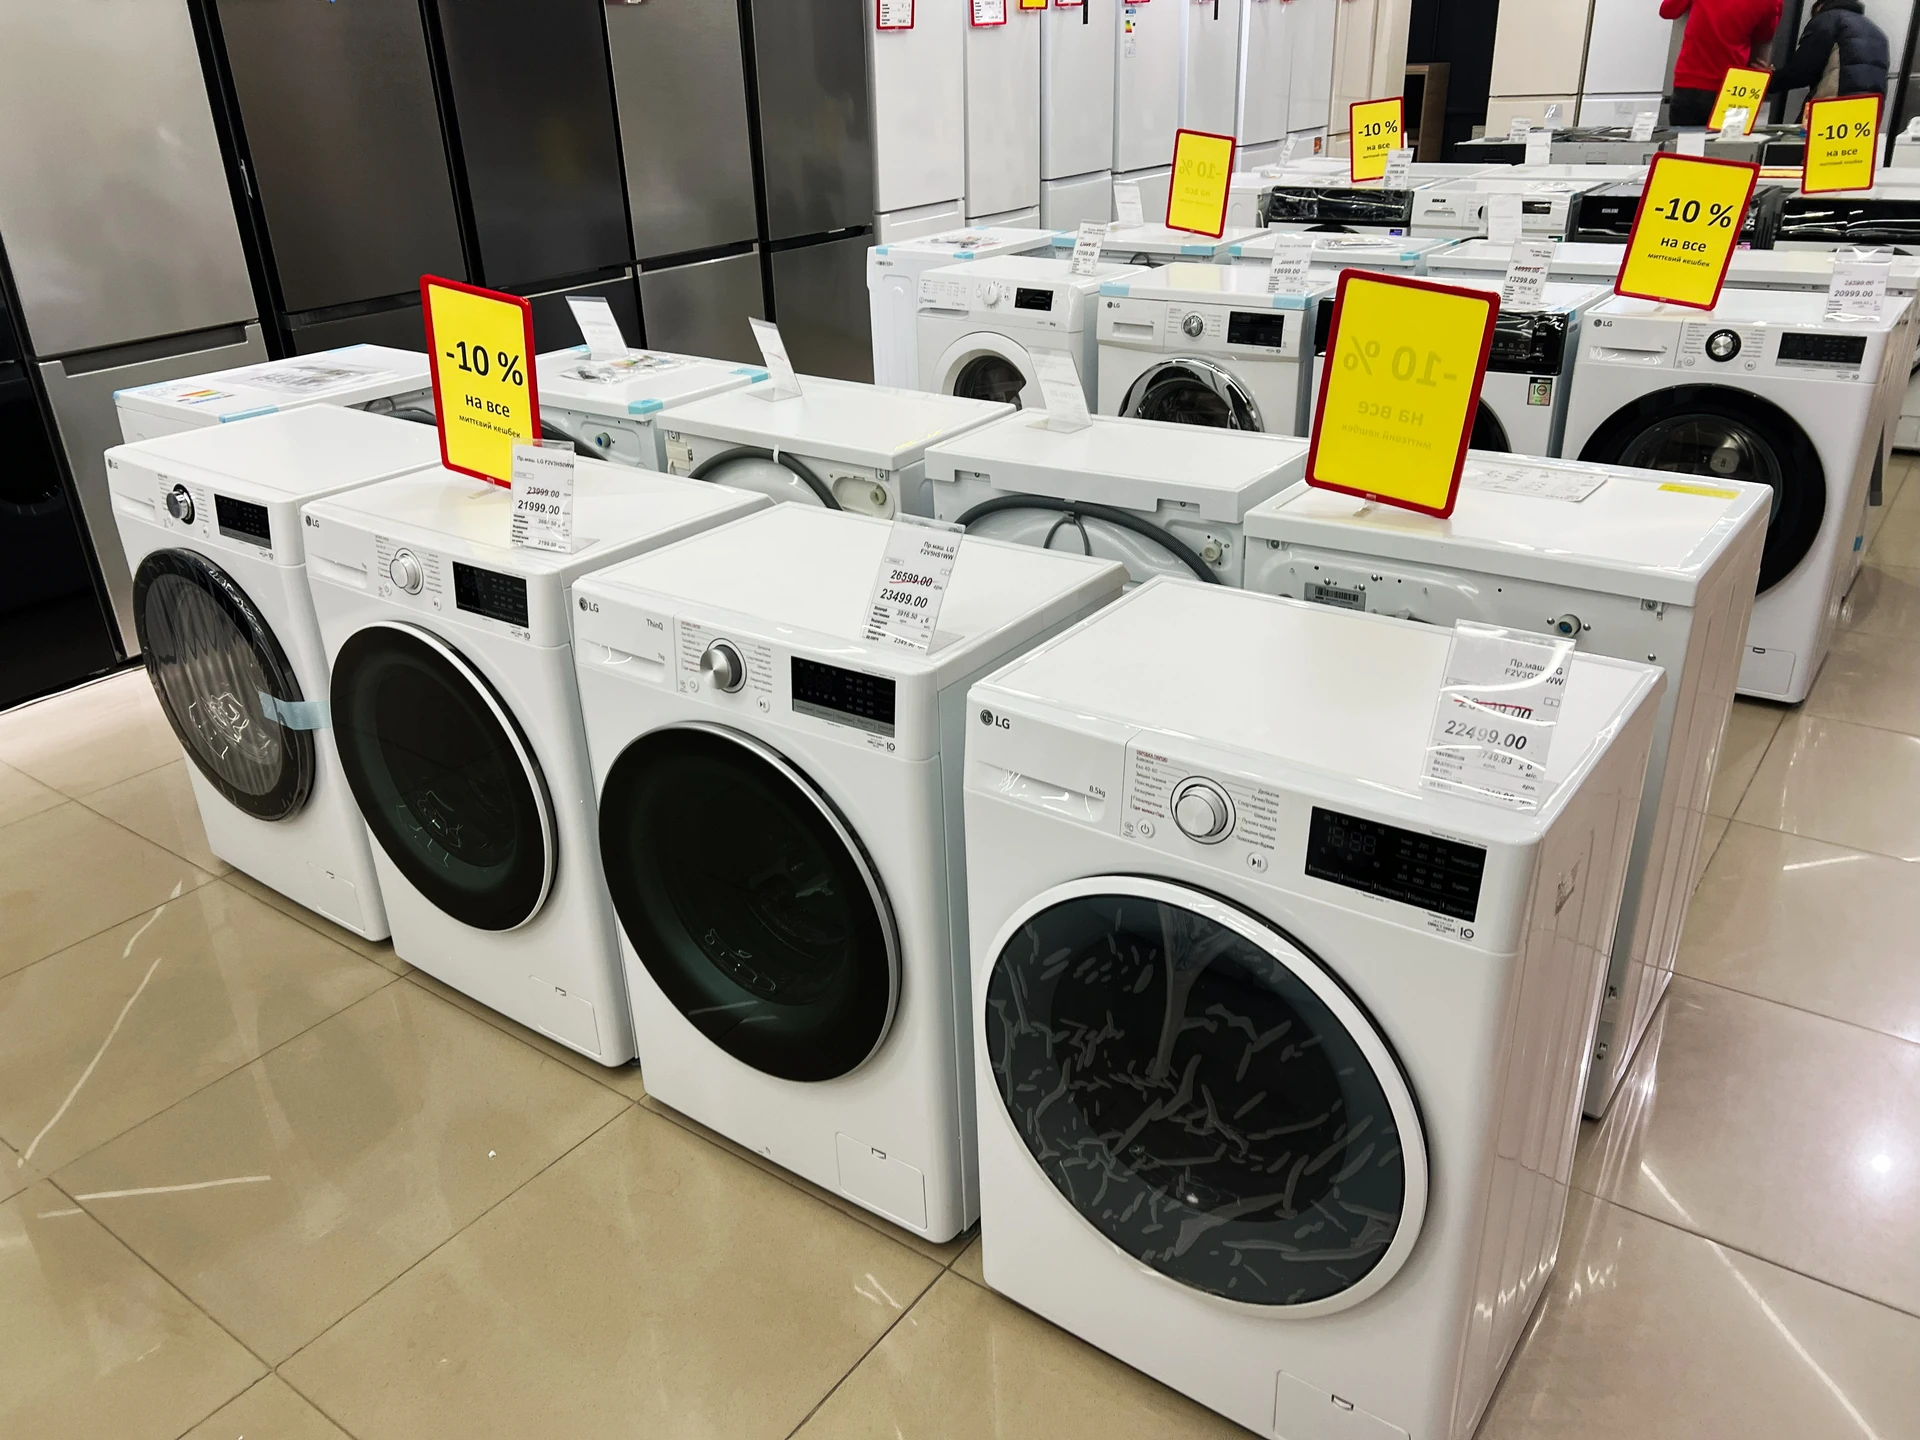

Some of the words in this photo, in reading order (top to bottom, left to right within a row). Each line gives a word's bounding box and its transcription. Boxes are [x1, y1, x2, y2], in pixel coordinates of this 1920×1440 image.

[1727, 85, 1746, 97] -10
[1749, 88, 1761, 99] %
[1358, 123, 1380, 136] -10
[1385, 120, 1397, 134] %
[1818, 124, 1848, 140] -10
[1854, 122, 1870, 137] %
[1841, 148, 1858, 156] все
[1654, 196, 1701, 224] -10
[1708, 202, 1732, 228] %
[1661, 234, 1679, 249] на
[1682, 239, 1707, 253] все
[1647, 251, 1681, 265] миттєвий
[1682, 256, 1711, 268] кешбек
[1509, 276, 1537, 284] 13299.00
[1602, 320, 1613, 328] LG
[445, 340, 490, 378] -10
[498, 352, 523, 386] %
[465, 394, 482, 409] на
[486, 400, 510, 419] все
[459, 414, 492, 430] миттєвий
[493, 425, 521, 439] кешбек
[518, 500, 560, 515] 21999.00
[312, 519, 320, 529] LG
[890, 570, 933, 587] 26599.00
[880, 588, 928, 608] 23499.00
[589, 602, 599, 613] LG
[896, 610, 918, 620] 3916.50
[646, 619, 664, 631] ThinQ
[995, 715, 1011, 730] LG
[1445, 720, 1527, 750] 22499.00
[1089, 785, 1106, 798] 8.5kg
